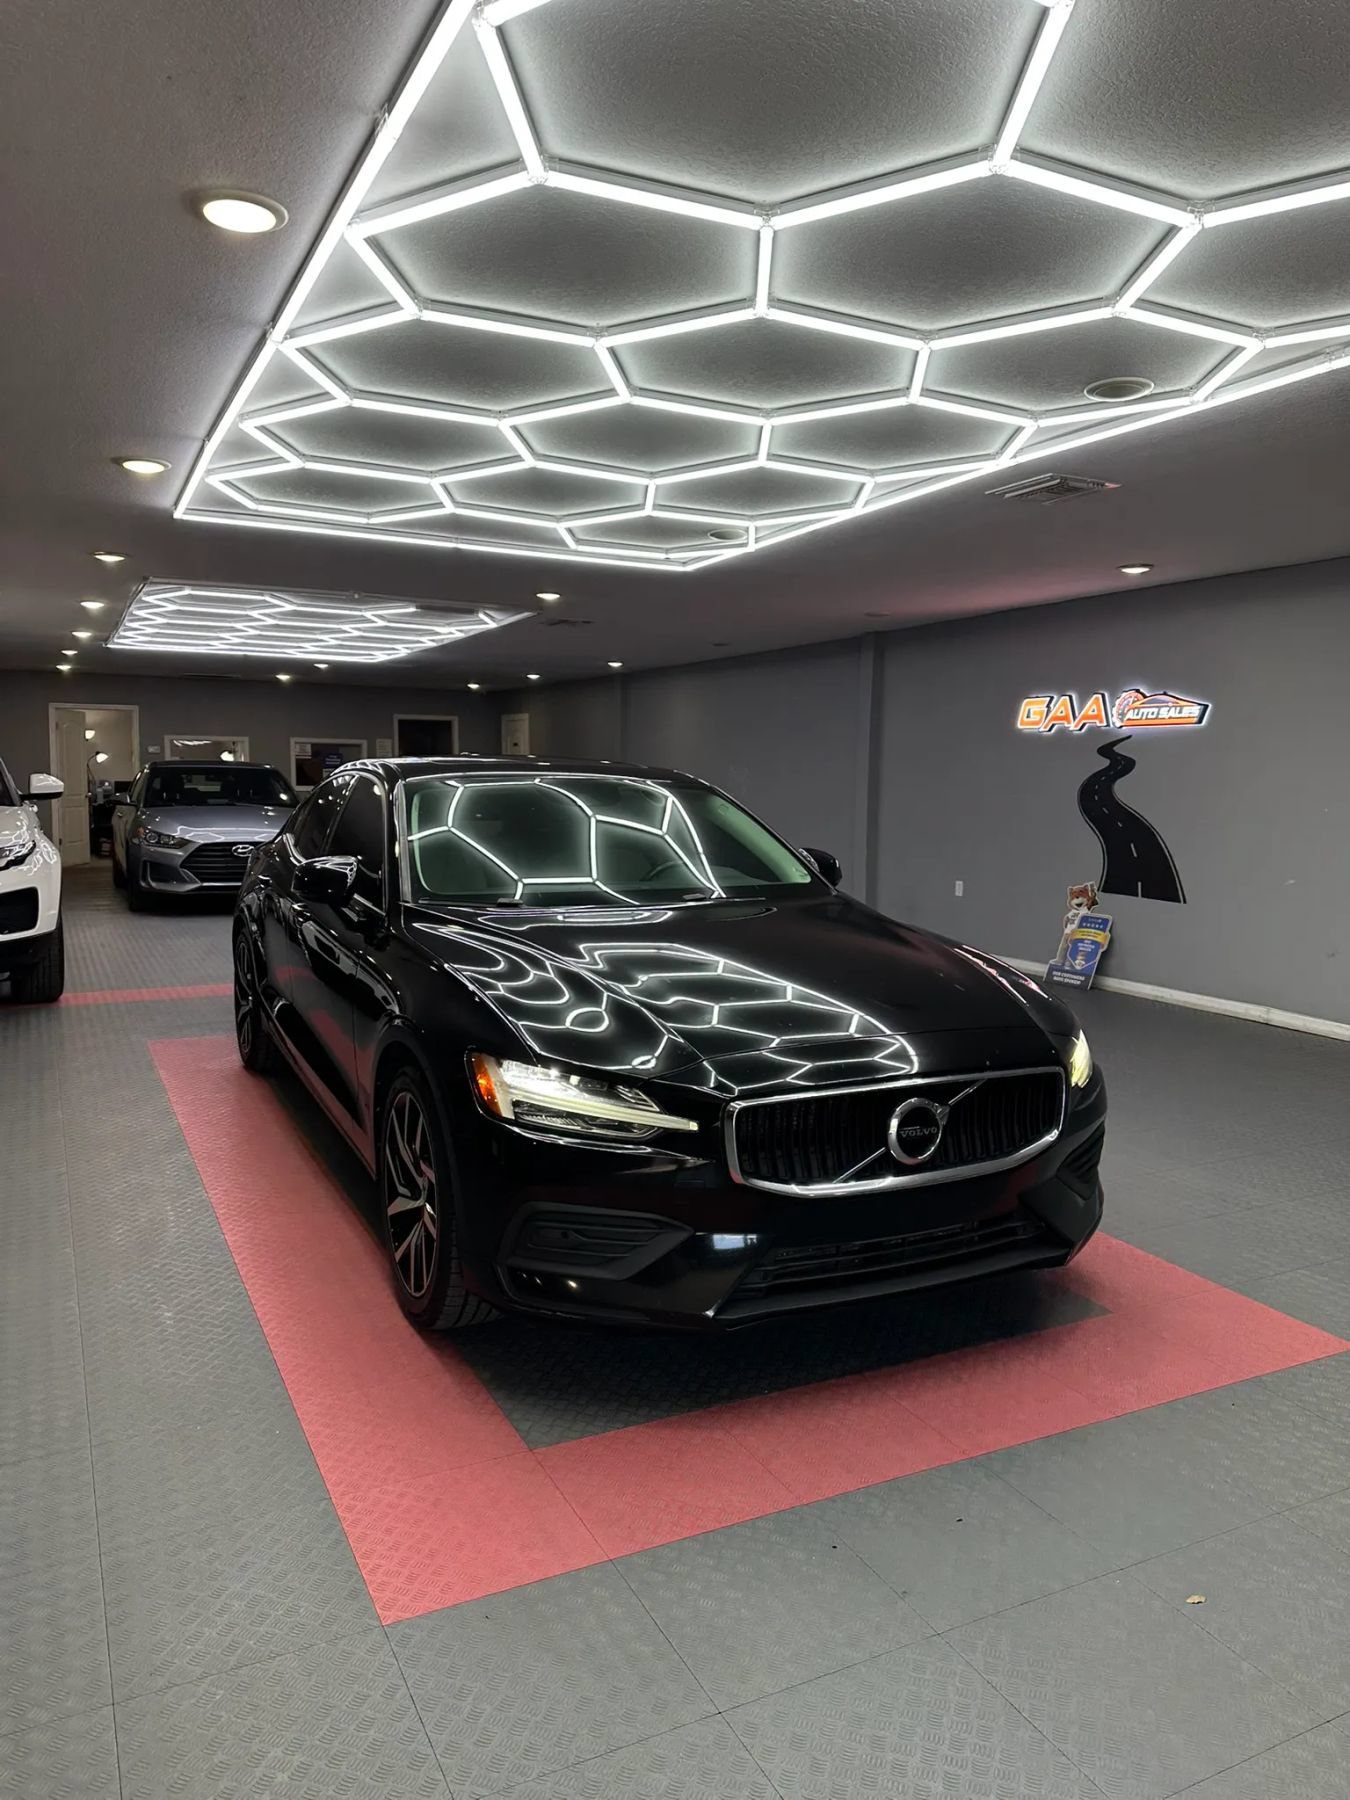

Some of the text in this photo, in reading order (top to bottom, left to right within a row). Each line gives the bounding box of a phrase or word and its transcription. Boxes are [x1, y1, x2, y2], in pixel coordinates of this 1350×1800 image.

[1018, 693, 1108, 732] GAA
[1125, 705, 1201, 720] AUTO SALES
[900, 1126, 938, 1138] VOLVO
